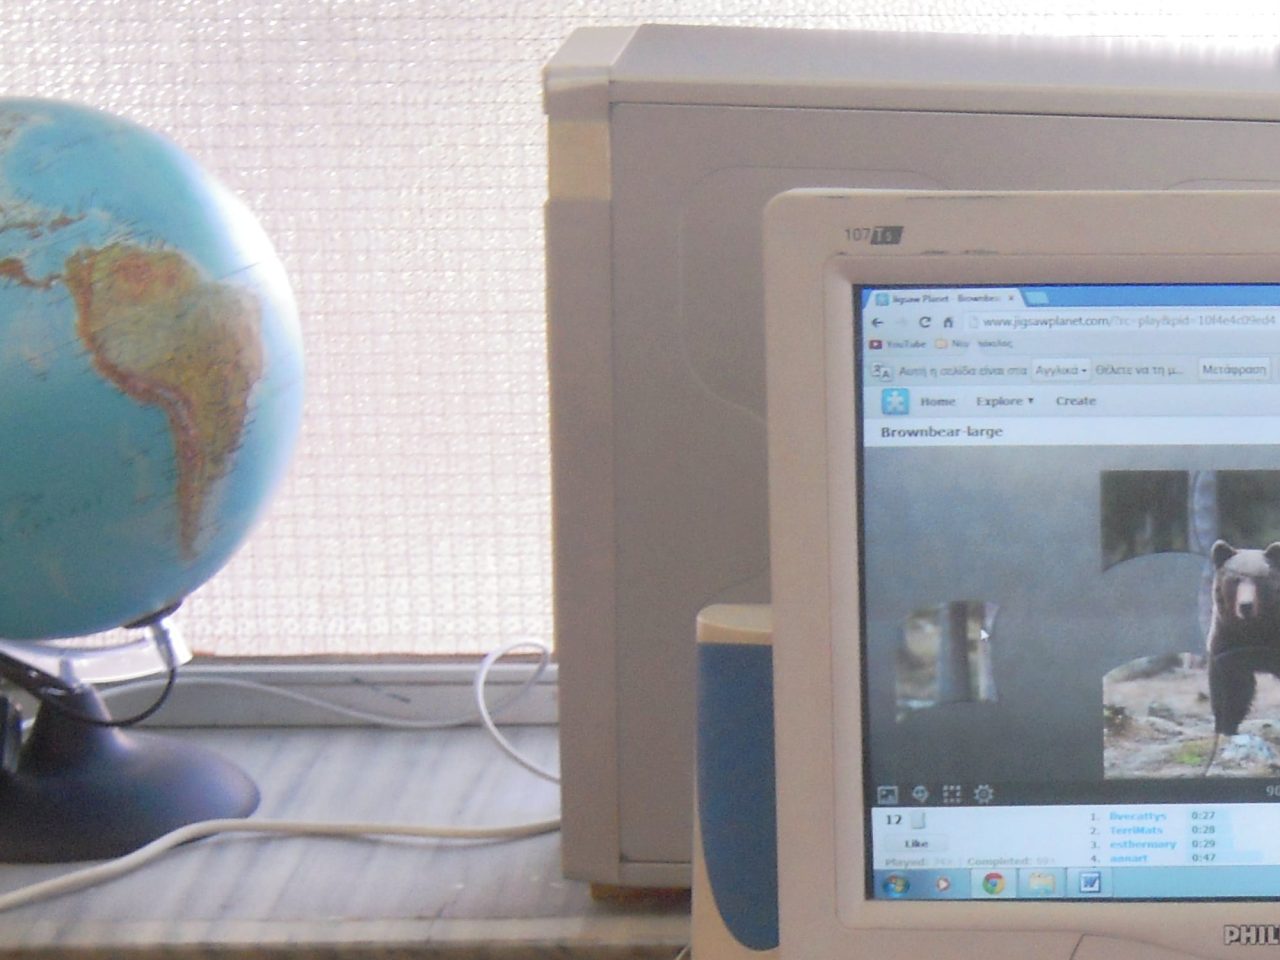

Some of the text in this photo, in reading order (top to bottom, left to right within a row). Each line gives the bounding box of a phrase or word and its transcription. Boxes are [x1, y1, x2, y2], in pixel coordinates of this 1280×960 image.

[1035, 365, 1078, 377] Αγγλικά
[1095, 365, 1132, 376] Θέλετε
[1136, 367, 1149, 376] να
[1152, 366, 1165, 377] τη
[1203, 364, 1266, 377] Μετάφραση
[921, 397, 956, 407] Home
[976, 396, 1023, 408] Explore
[1056, 396, 1096, 407] Create
[1191, 810, 1215, 819] 0:27
[905, 839, 929, 848] Like
[1191, 840, 1215, 848] 0:29
[1191, 854, 1215, 863] 0:47
